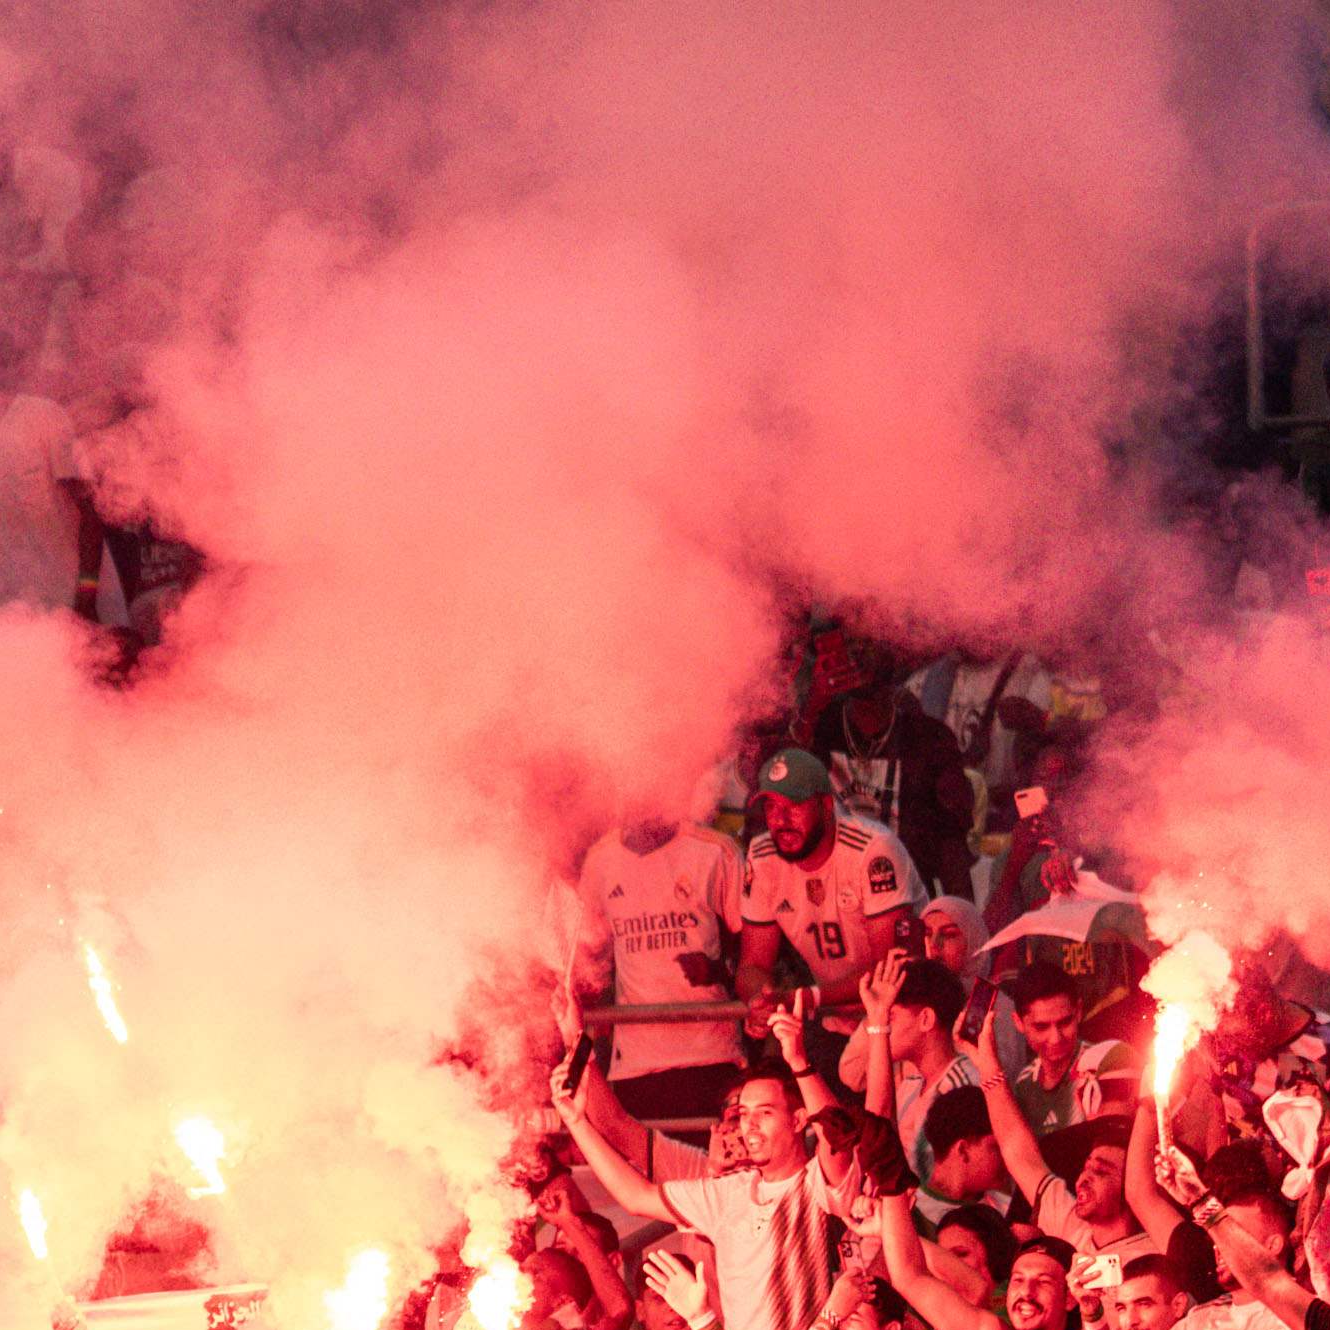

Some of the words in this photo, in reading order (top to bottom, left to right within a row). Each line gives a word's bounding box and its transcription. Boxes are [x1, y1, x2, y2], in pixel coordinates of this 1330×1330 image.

[612, 909, 699, 938] Emirates
[625, 934, 644, 953] FLY
[646, 931, 688, 951] BETTER
[806, 921, 847, 961] 19
